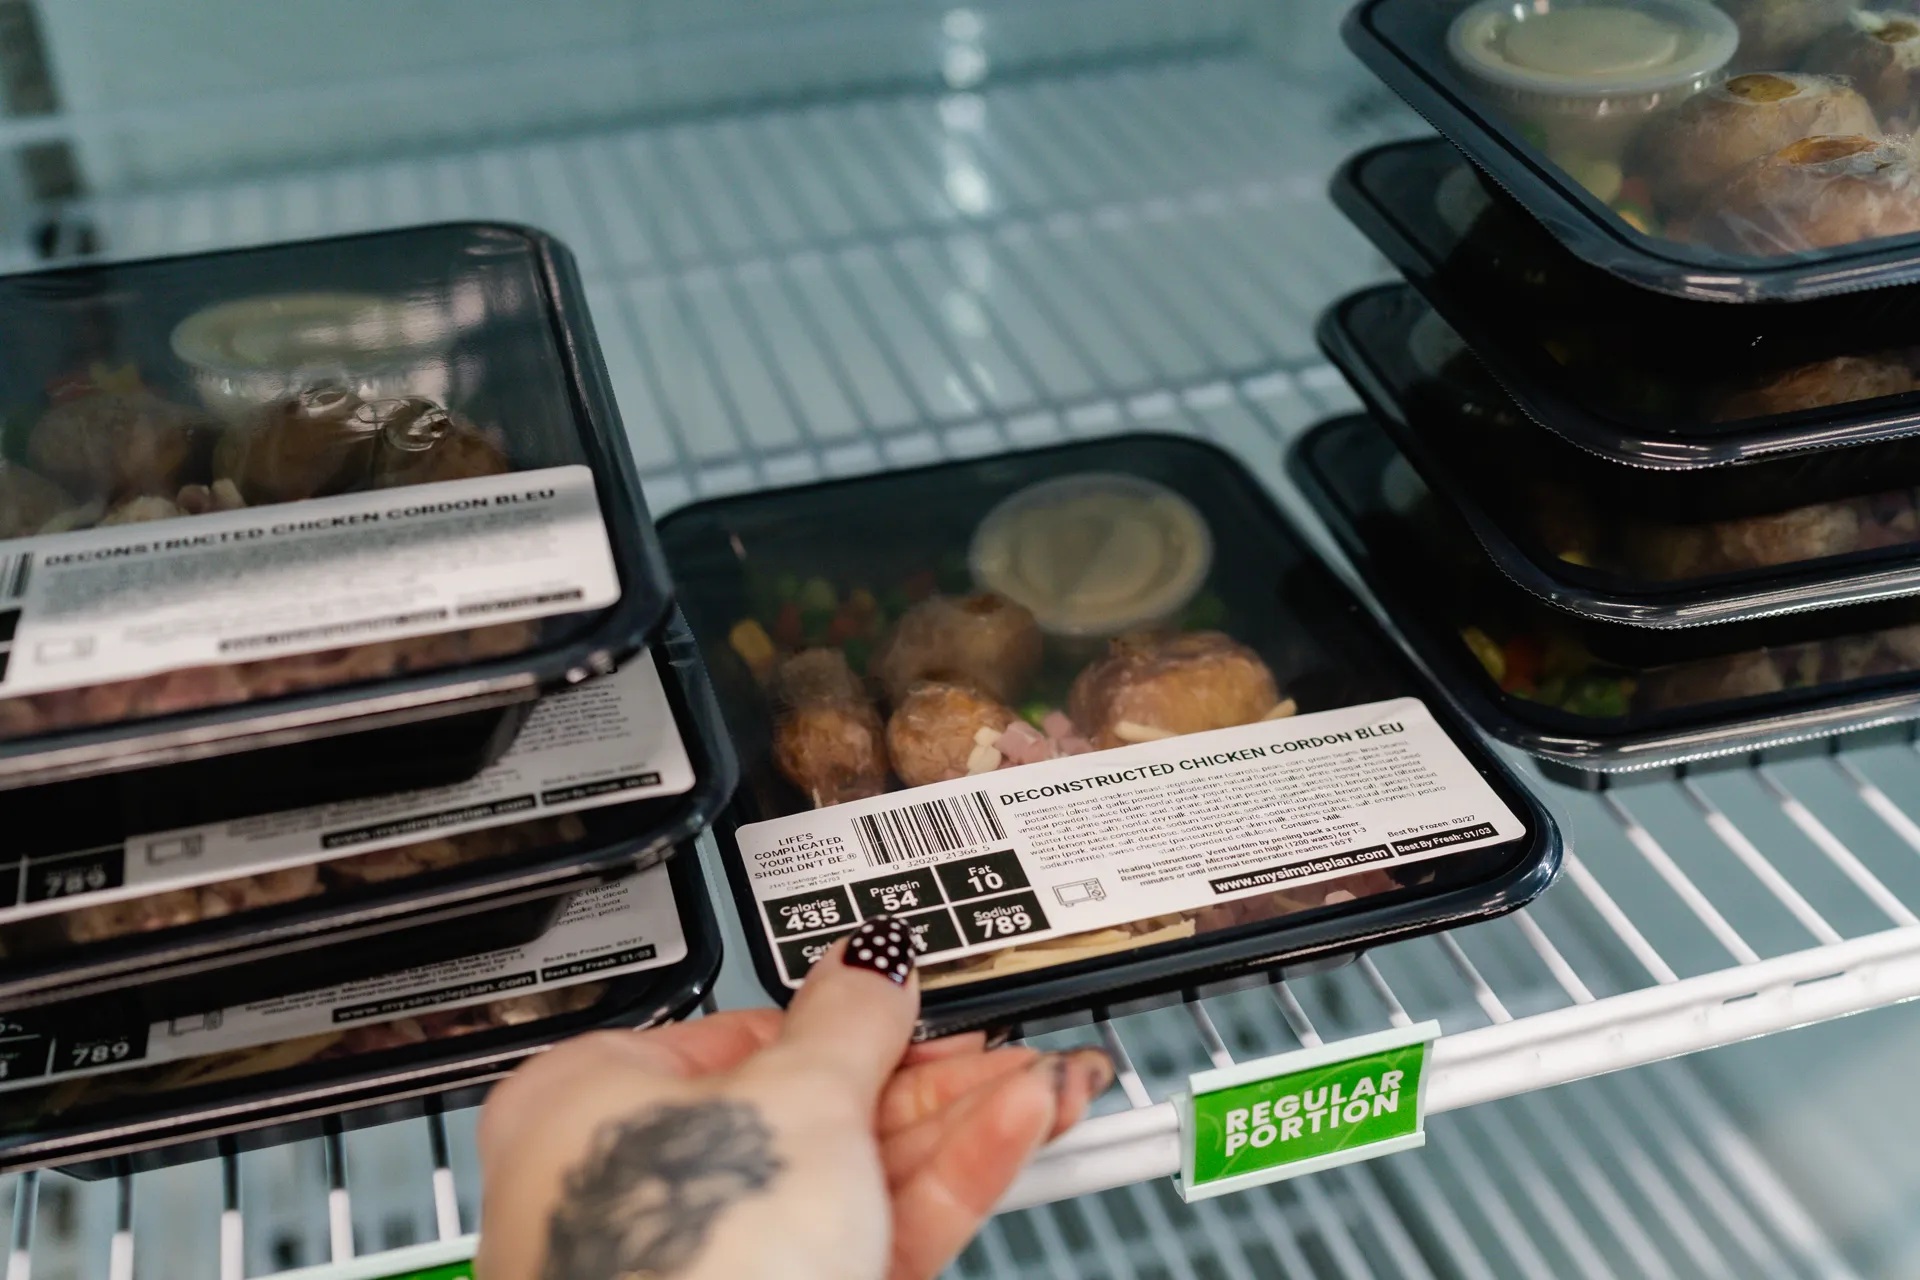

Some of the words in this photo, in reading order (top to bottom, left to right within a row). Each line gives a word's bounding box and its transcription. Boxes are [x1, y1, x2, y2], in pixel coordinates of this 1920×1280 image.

[46, 526, 264, 567] DECONSTRUCTED
[271, 511, 380, 537] CHICKEN
[387, 494, 489, 522] CORDON
[495, 487, 556, 507] BLEU
[999, 763, 1175, 806] DECONSTRUCTED
[1178, 746, 1267, 771] CHICKEN
[1269, 731, 1353, 755] CORDON
[1353, 721, 1405, 740] BLEU
[1386, 829, 1408, 838] Best
[1451, 814, 1476, 825] 03/27
[753, 836, 846, 861] COMPLICATED.
[777, 832, 814, 847] LIFE'S
[1395, 842, 1421, 853] Best
[1418, 839, 1433, 849] By
[1431, 833, 1464, 845] Fresh:
[1462, 826, 1493, 839] 01/03
[758, 856, 795, 870] YOUR
[795, 844, 845, 862] HEALTH
[891, 863, 901, 871] 0
[905, 855, 940, 868] 32020
[943, 847, 978, 860] 21366
[981, 844, 991, 852] 5
[1119, 870, 1157, 883] Remove
[1157, 865, 1184, 875] sauce
[1204, 851, 1251, 865] Microwave
[1263, 844, 1284, 853] high
[1284, 838, 1310, 850] (1200
[1310, 832, 1338, 843] watts)
[1337, 830, 1351, 838] for
[1351, 826, 1367, 835] 1-3
[754, 858, 824, 880] SHOULDN'T
[967, 864, 993, 877] Fat
[1214, 849, 1392, 895] www.mysimpleplan.com
[869, 880, 921, 898] Protein
[967, 872, 1004, 893] 10
[779, 898, 837, 917] Calories
[881, 889, 919, 912] 54
[972, 904, 1025, 923] Sodium
[785, 905, 841, 931] 435
[974, 911, 1033, 939] 789
[570, 964, 584, 974] By
[72, 1041, 130, 1067] 789
[1226, 1070, 1404, 1135] REGULAR
[1225, 1090, 1399, 1157] PORTION
